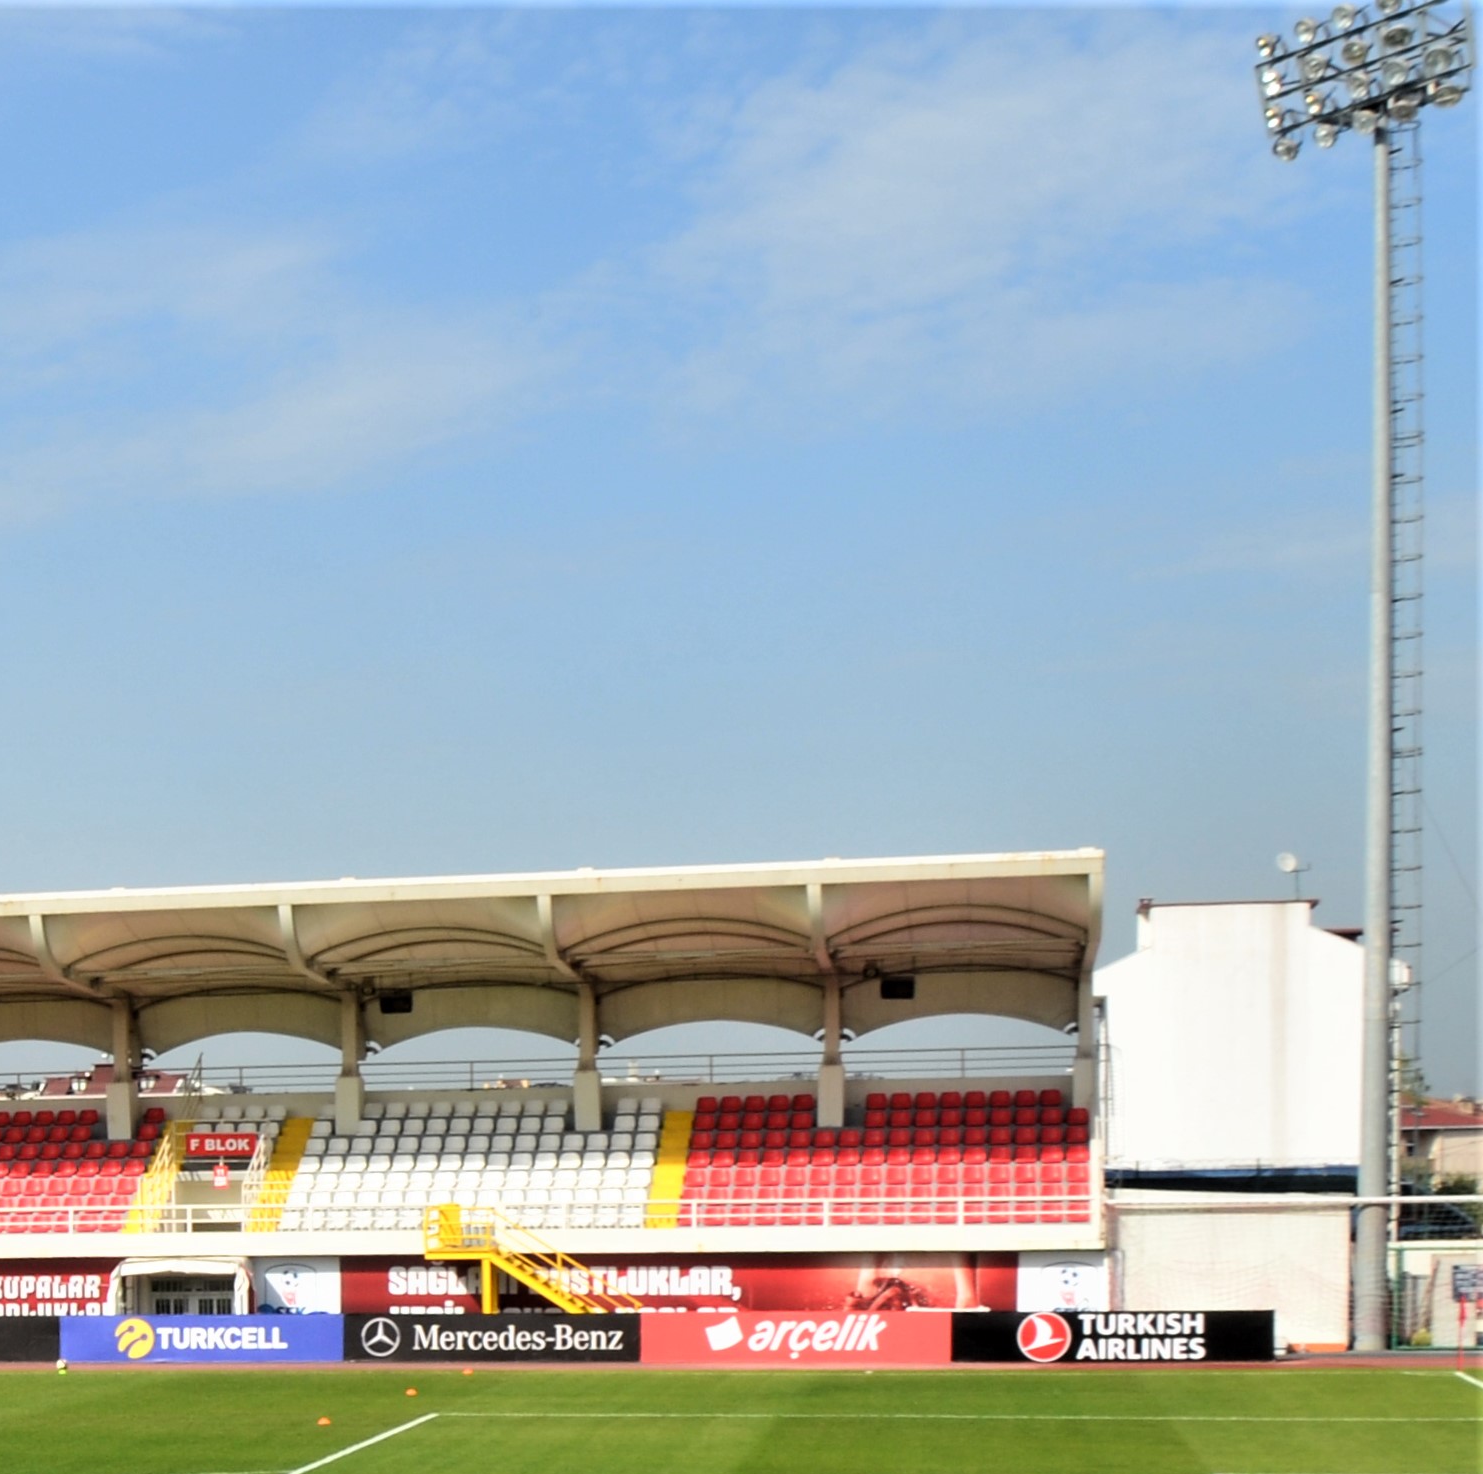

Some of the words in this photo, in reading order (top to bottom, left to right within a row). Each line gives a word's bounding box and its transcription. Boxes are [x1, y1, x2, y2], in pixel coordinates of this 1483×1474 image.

[190, 1139, 200, 1151] F
[204, 1138, 250, 1151] BLOK
[1077, 1313, 1205, 1336] TURKISH
[156, 1326, 288, 1350] TURKCELL
[412, 1323, 624, 1351] Mercedes-Benz
[747, 1314, 887, 1359] arçelik
[1076, 1337, 1206, 1360] AIRLINES
